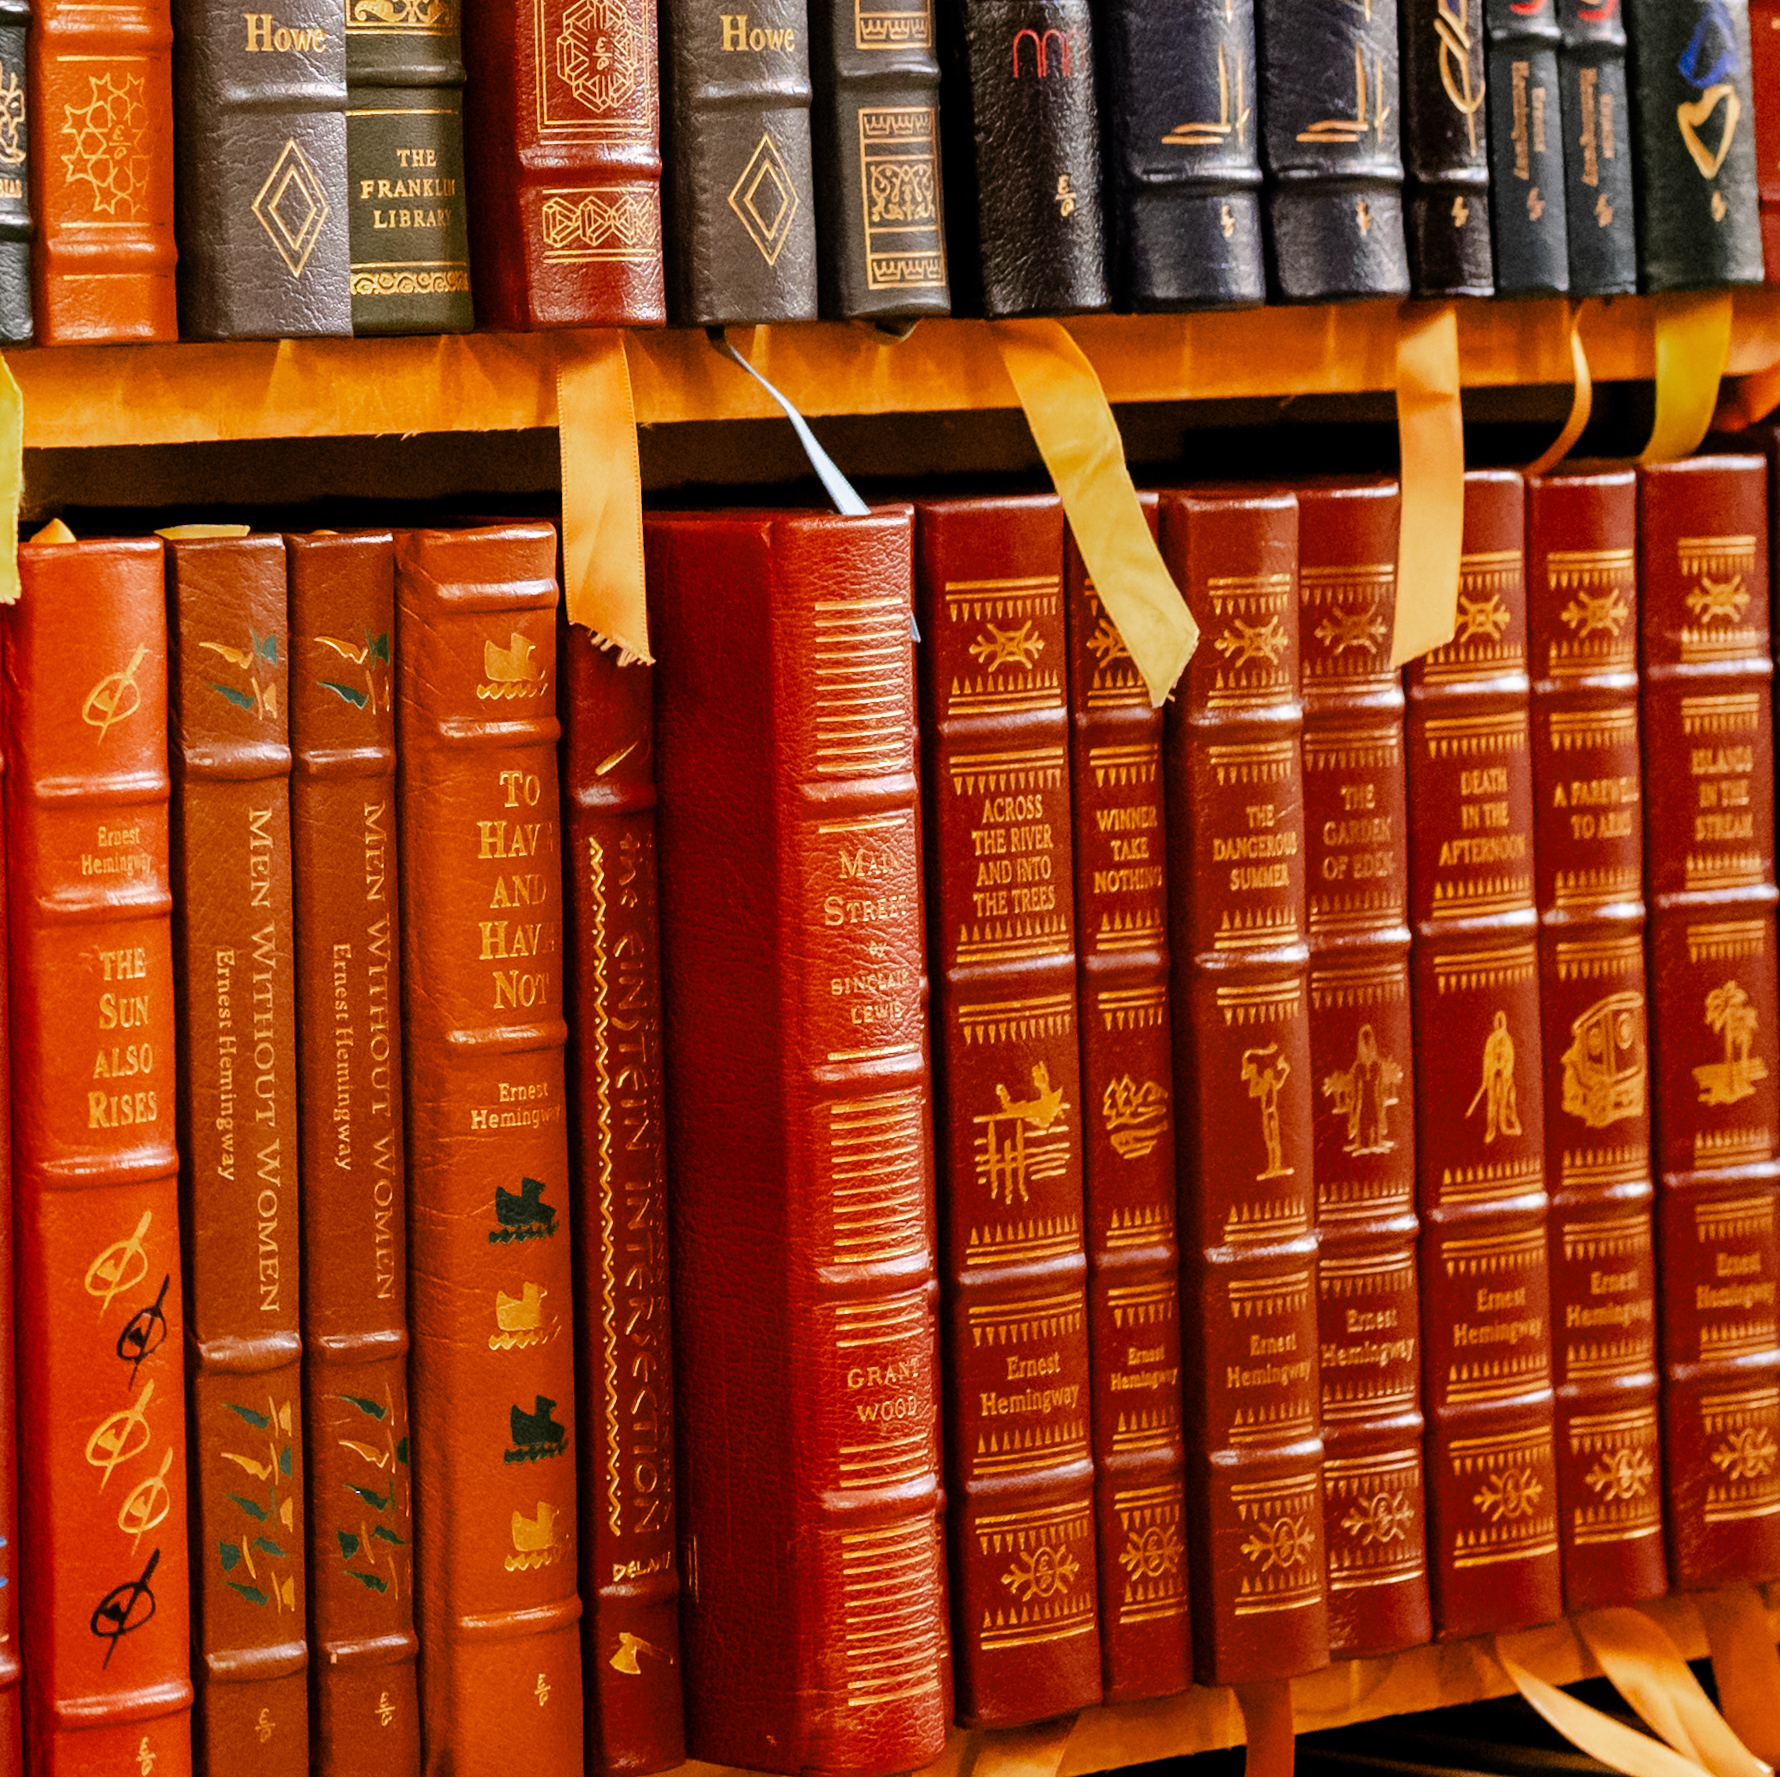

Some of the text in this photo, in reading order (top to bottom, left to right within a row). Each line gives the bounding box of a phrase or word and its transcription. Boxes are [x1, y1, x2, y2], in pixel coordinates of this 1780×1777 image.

[243, 13, 325, 54] Howe
[719, 14, 794, 53] Howe
[396, 149, 436, 167] THE
[360, 178, 455, 200] FRANKLIN
[372, 209, 451, 229] LIBRARY
[499, 770, 541, 807] TO
[983, 794, 1043, 824] ACROSS
[1097, 806, 1157, 831] WINNER
[1247, 805, 1275, 828] THE
[98, 826, 140, 848] Ernest
[972, 825, 1053, 855] THE RIVER
[1111, 838, 1148, 860] TAKE
[1214, 832, 1296, 861] DANGEROUS
[1440, 835, 1526, 866] AFTERNOON
[81, 853, 151, 876] Hemingway
[977, 857, 1051, 886] AND INTO
[1230, 863, 1289, 891] SUMMER
[490, 874, 546, 908] AND
[1094, 866, 1162, 894] NOTHING
[824, 892, 907, 927] STREET
[974, 885, 1055, 917] THE TREES
[99, 948, 146, 982] THE
[493, 970, 549, 1009] NOT
[99, 993, 149, 1029] SUN
[851, 1003, 903, 1026] LEWIS
[93, 1043, 153, 1080] ALSO
[216, 949, 236, 1180] Ernest Hemingway
[248, 808, 281, 1312] MEN WITHOUT WOMEN
[499, 1082, 548, 1103] Ernest
[88, 1089, 157, 1129] RISES
[847, 1358, 918, 1388] GRANT
[1006, 1355, 1061, 1380] Ernest
[856, 1396, 918, 1423] WOOD
[980, 1382, 1080, 1416] Hemingway
